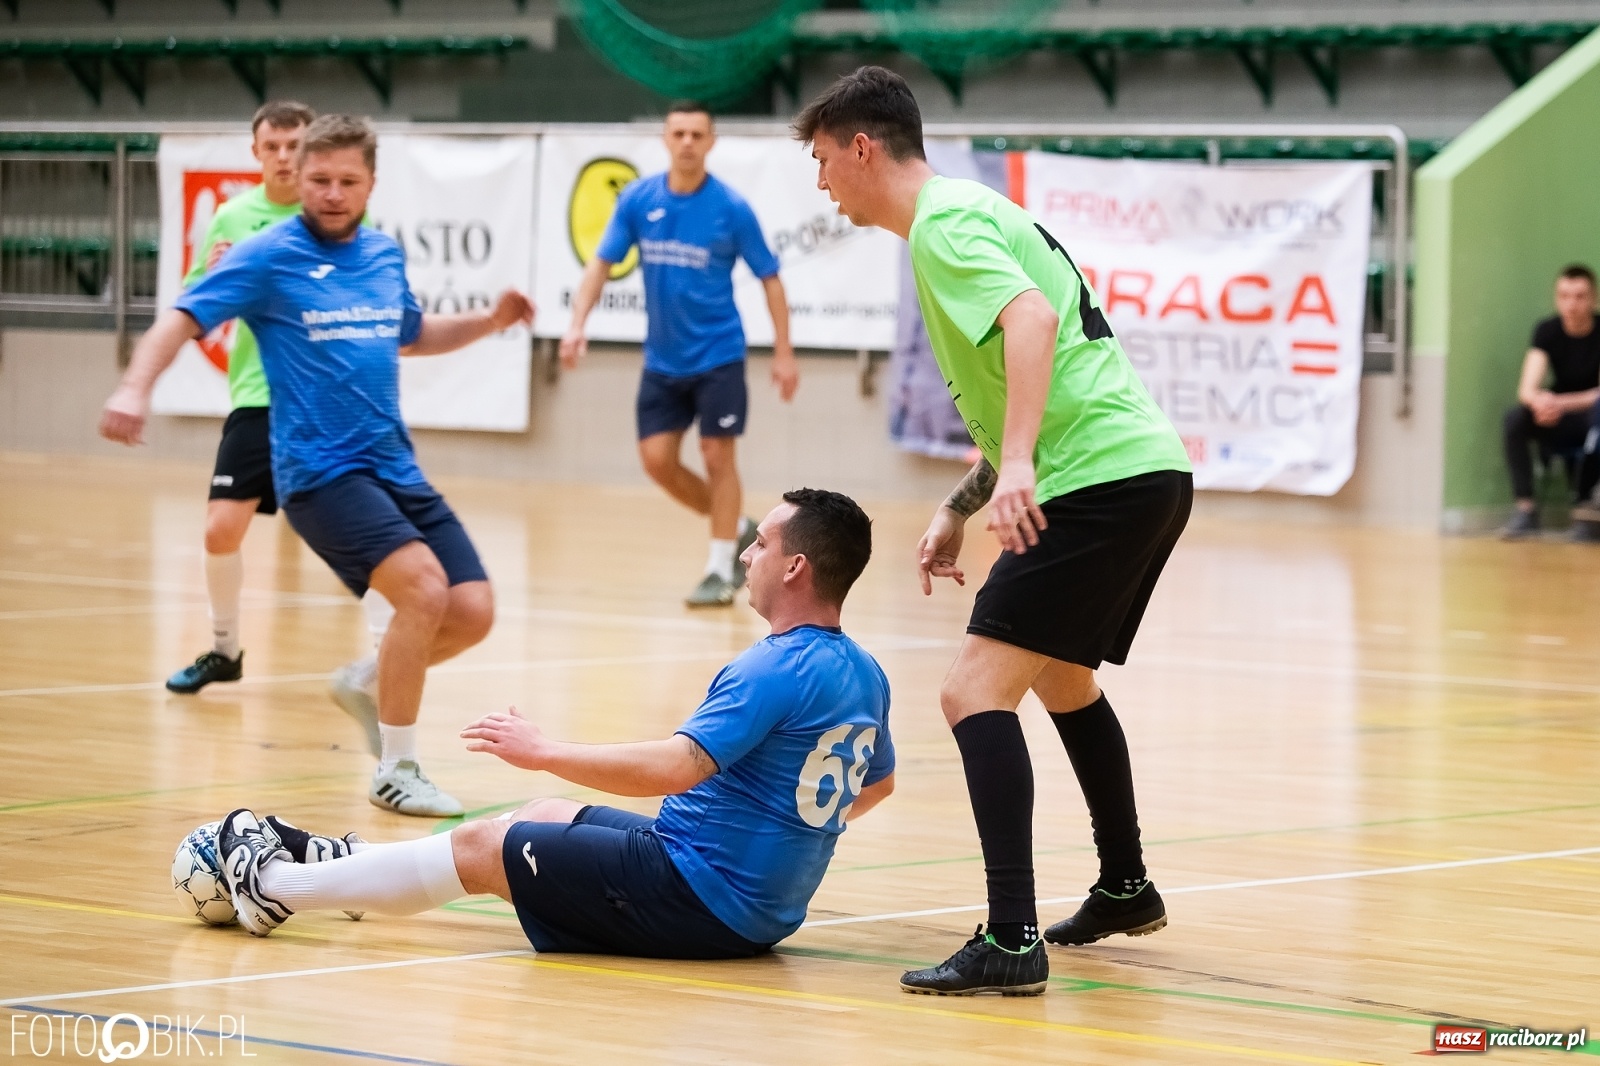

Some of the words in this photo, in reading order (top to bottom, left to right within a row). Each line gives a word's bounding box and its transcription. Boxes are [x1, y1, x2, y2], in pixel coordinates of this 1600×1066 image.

[1216, 198, 1345, 231] WORK
[375, 219, 492, 269] ASTO
[1077, 265, 1337, 327] RACA
[1120, 330, 1284, 376] STRIA
[1152, 381, 1332, 428] IEMCY
